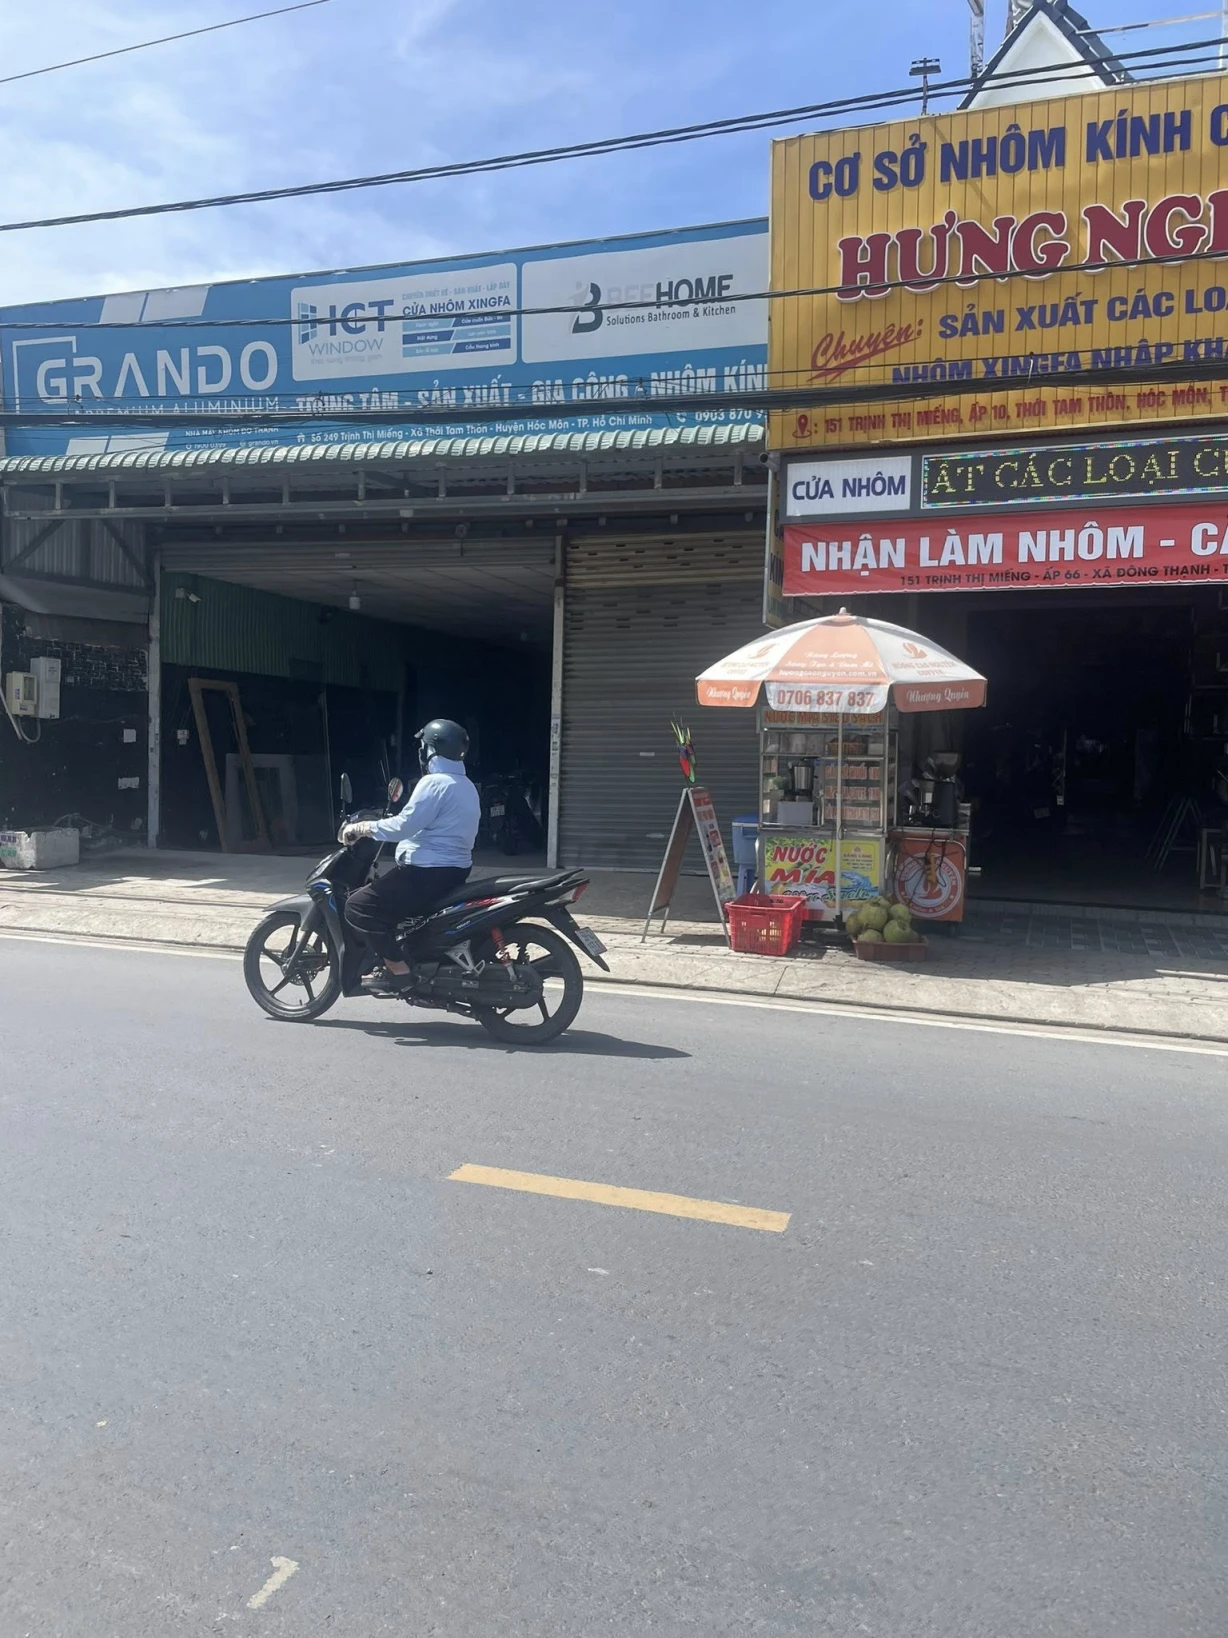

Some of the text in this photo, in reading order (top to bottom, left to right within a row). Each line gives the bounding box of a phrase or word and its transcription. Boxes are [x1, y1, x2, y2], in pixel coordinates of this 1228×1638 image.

[808, 152, 861, 200] CƠ
[873, 133, 927, 191] SỞ
[940, 123, 1066, 183] NHÔM
[1086, 108, 1192, 163] KÍNH
[837, 209, 1070, 301] HƯNG
[403, 295, 511, 316] CỬA NHÔM XINGFA
[606, 305, 736, 326] Solutions Bathroom & Kitchen
[938, 286, 1228, 340] SẢN XUẤT CÁC LO
[309, 337, 384, 355] WINDOW
[808, 318, 924, 374] Chuyên:
[892, 357, 973, 384] NHÔM
[983, 352, 1082, 379] XINGFA
[1184, 336, 1228, 361] KH
[37, 341, 278, 404] GRANDO
[359, 387, 398, 409] TÂM
[417, 379, 456, 408] SẢN
[463, 374, 512, 407] XUẤT
[532, 379, 565, 405] GIA
[572, 371, 628, 401] CÔNG
[650, 363, 716, 395] NHÔM
[729, 408, 752, 420] 870
[824, 418, 842, 433] 151
[848, 414, 885, 433] TRỊNH
[891, 412, 911, 430] THỊ
[969, 401, 987, 422] ẤP
[991, 404, 1010, 420] 10,
[1052, 397, 1082, 415] TAM
[1137, 387, 1165, 408] HÓC
[311, 433, 321, 442] Số
[323, 432, 338, 441] 249
[340, 431, 360, 442] Trịnh
[377, 428, 403, 440] Miếng
[446, 426, 463, 435] Tam
[495, 422, 525, 434] Huyện
[527, 420, 545, 430] Hóc
[549, 419, 568, 429] Môn
[577, 418, 590, 428] TP.
[608, 415, 625, 425] Chí
[628, 414, 652, 424] Minh
[994, 453, 1072, 488] CÁC
[1083, 451, 1180, 485] LOẠI
[1194, 448, 1228, 477] C
[792, 471, 906, 501] CỬA NHÔM
[801, 533, 906, 577] NHẬN
[918, 527, 1004, 569] LÀM
[1017, 520, 1145, 564] NHÔM
[901, 575, 920, 586] 151
[925, 574, 961, 587] TRỊNH
[965, 573, 985, 585] THỊ
[989, 567, 1030, 582] MIẾNG
[1042, 566, 1060, 581] ẤP
[1064, 569, 1081, 580] 66
[1092, 566, 1112, 579] XÃ
[1116, 564, 1159, 578] ĐÔNG
[1163, 564, 1211, 579] THẠNH
[777, 689, 875, 707] 0706 837 837
[772, 843, 828, 864] NƯỚC
[769, 866, 836, 885] MÍA
